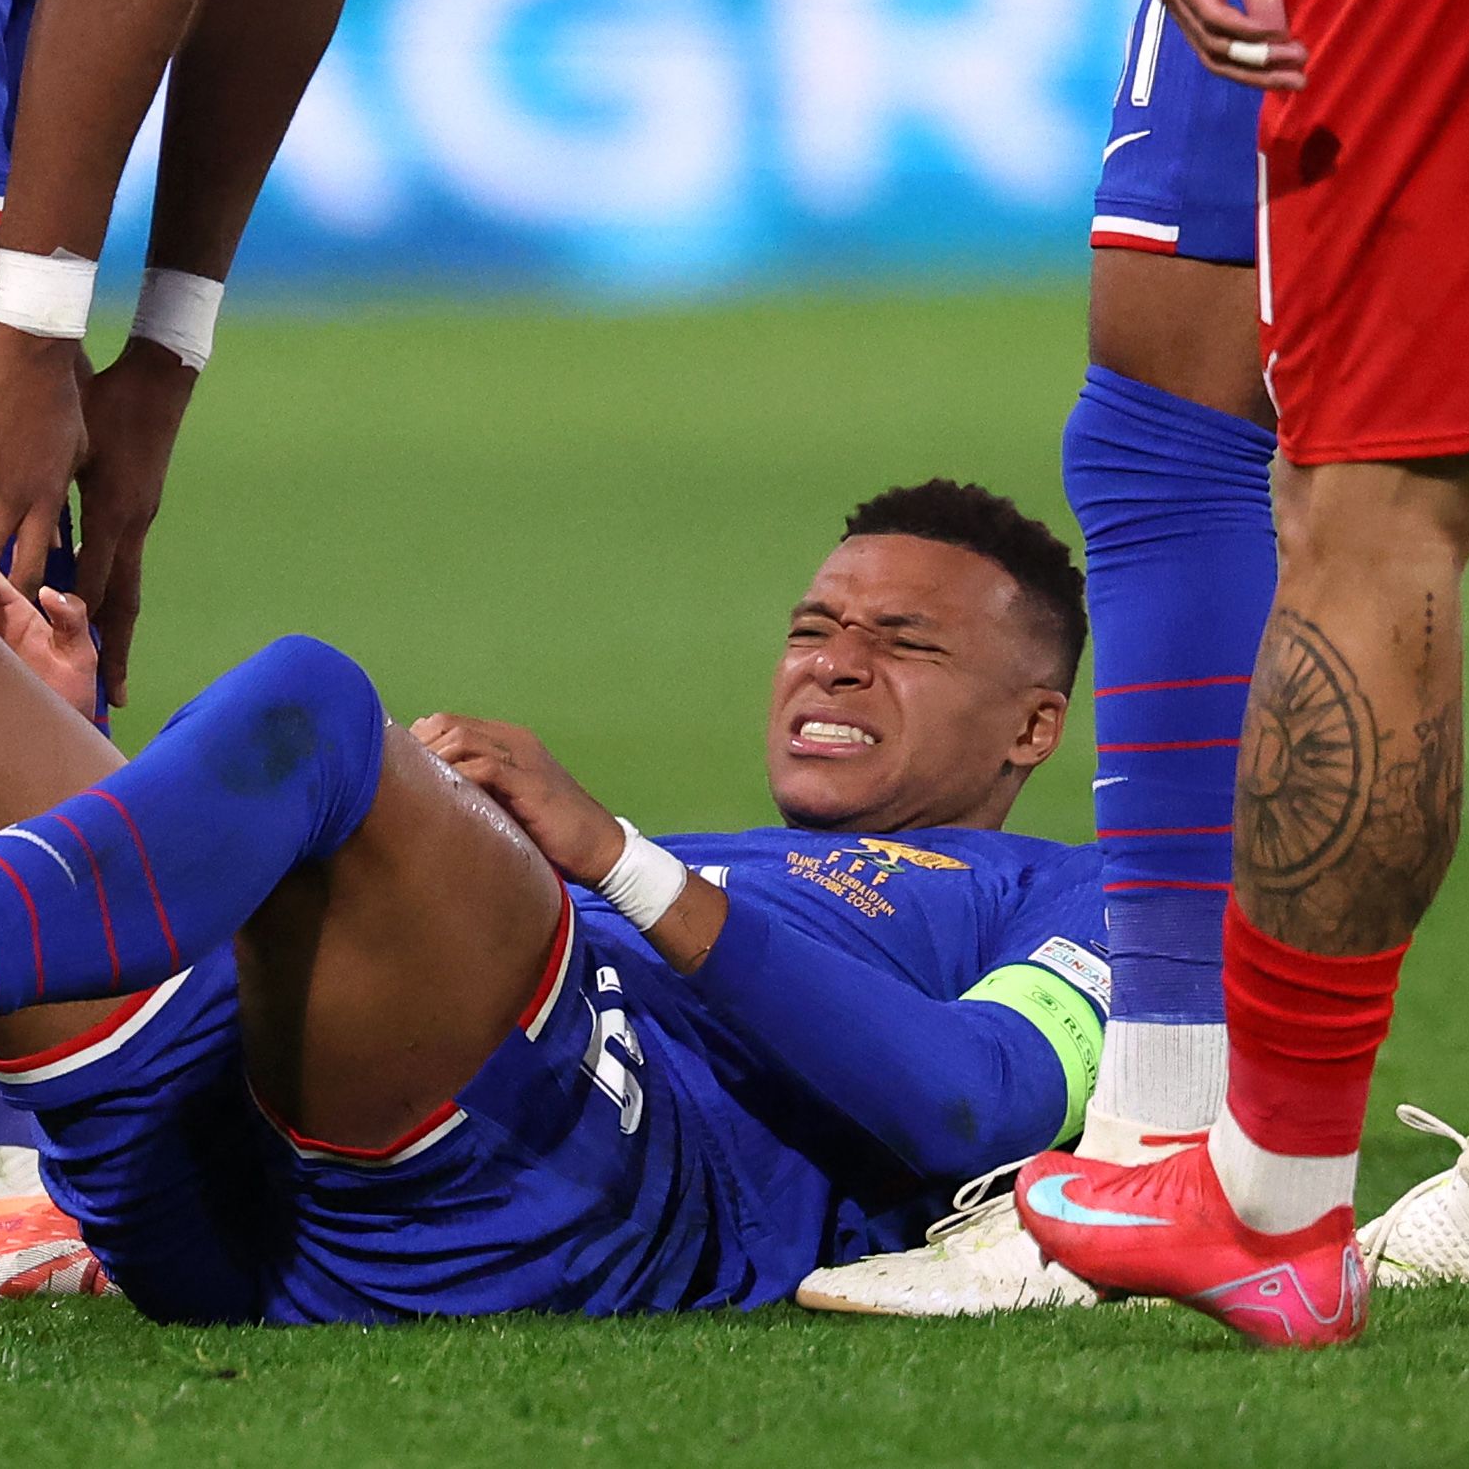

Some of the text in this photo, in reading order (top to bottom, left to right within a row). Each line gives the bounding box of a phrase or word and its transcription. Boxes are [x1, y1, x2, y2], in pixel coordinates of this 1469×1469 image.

[786, 851, 823, 872] FRANCE
[829, 868, 896, 917] AZERBAIDJAN
[803, 869, 848, 897] OCTOBRE
[845, 892, 880, 919] 2025
